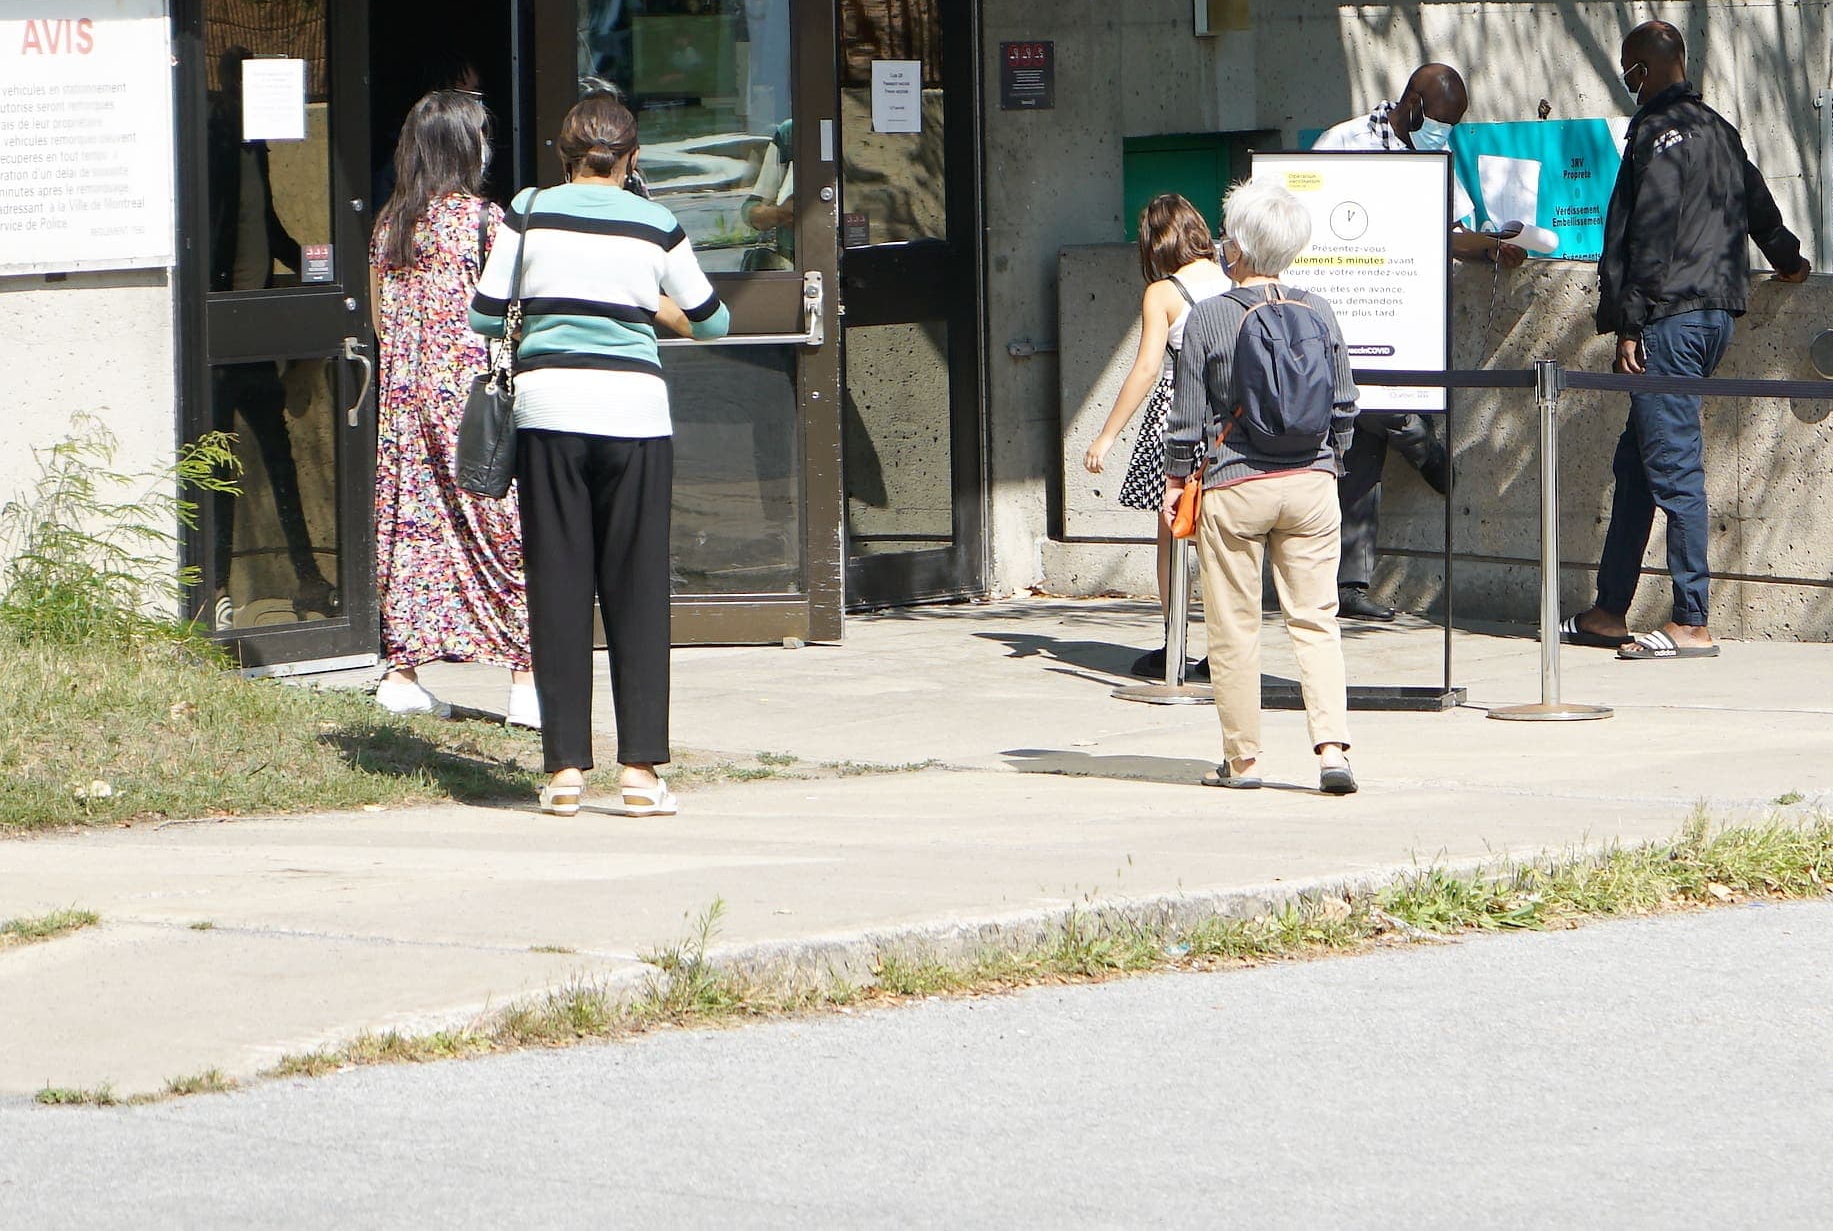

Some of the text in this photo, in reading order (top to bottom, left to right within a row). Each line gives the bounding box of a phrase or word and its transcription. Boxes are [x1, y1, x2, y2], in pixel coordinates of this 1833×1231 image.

[21, 17, 95, 55] AVIS
[1, 121, 15, 131] ais
[18, 117, 30, 130] de
[32, 117, 50, 130] leur
[46, 153, 57, 163] en
[60, 150, 79, 162] tout
[0, 170, 28, 182] ration
[69, 199, 89, 211] Ville
[1555, 204, 1600, 216] Verdissement
[0, 217, 68, 232] rvice de Police
[1552, 216, 1604, 228] Embellissement
[1293, 255, 1415, 265] ulement 5 minutes avant
[1313, 267, 1326, 276] de
[1329, 268, 1354, 276] votre
[1346, 296, 1404, 306] demandons
[1335, 308, 1349, 317] nir
[1351, 308, 1372, 318] plus
